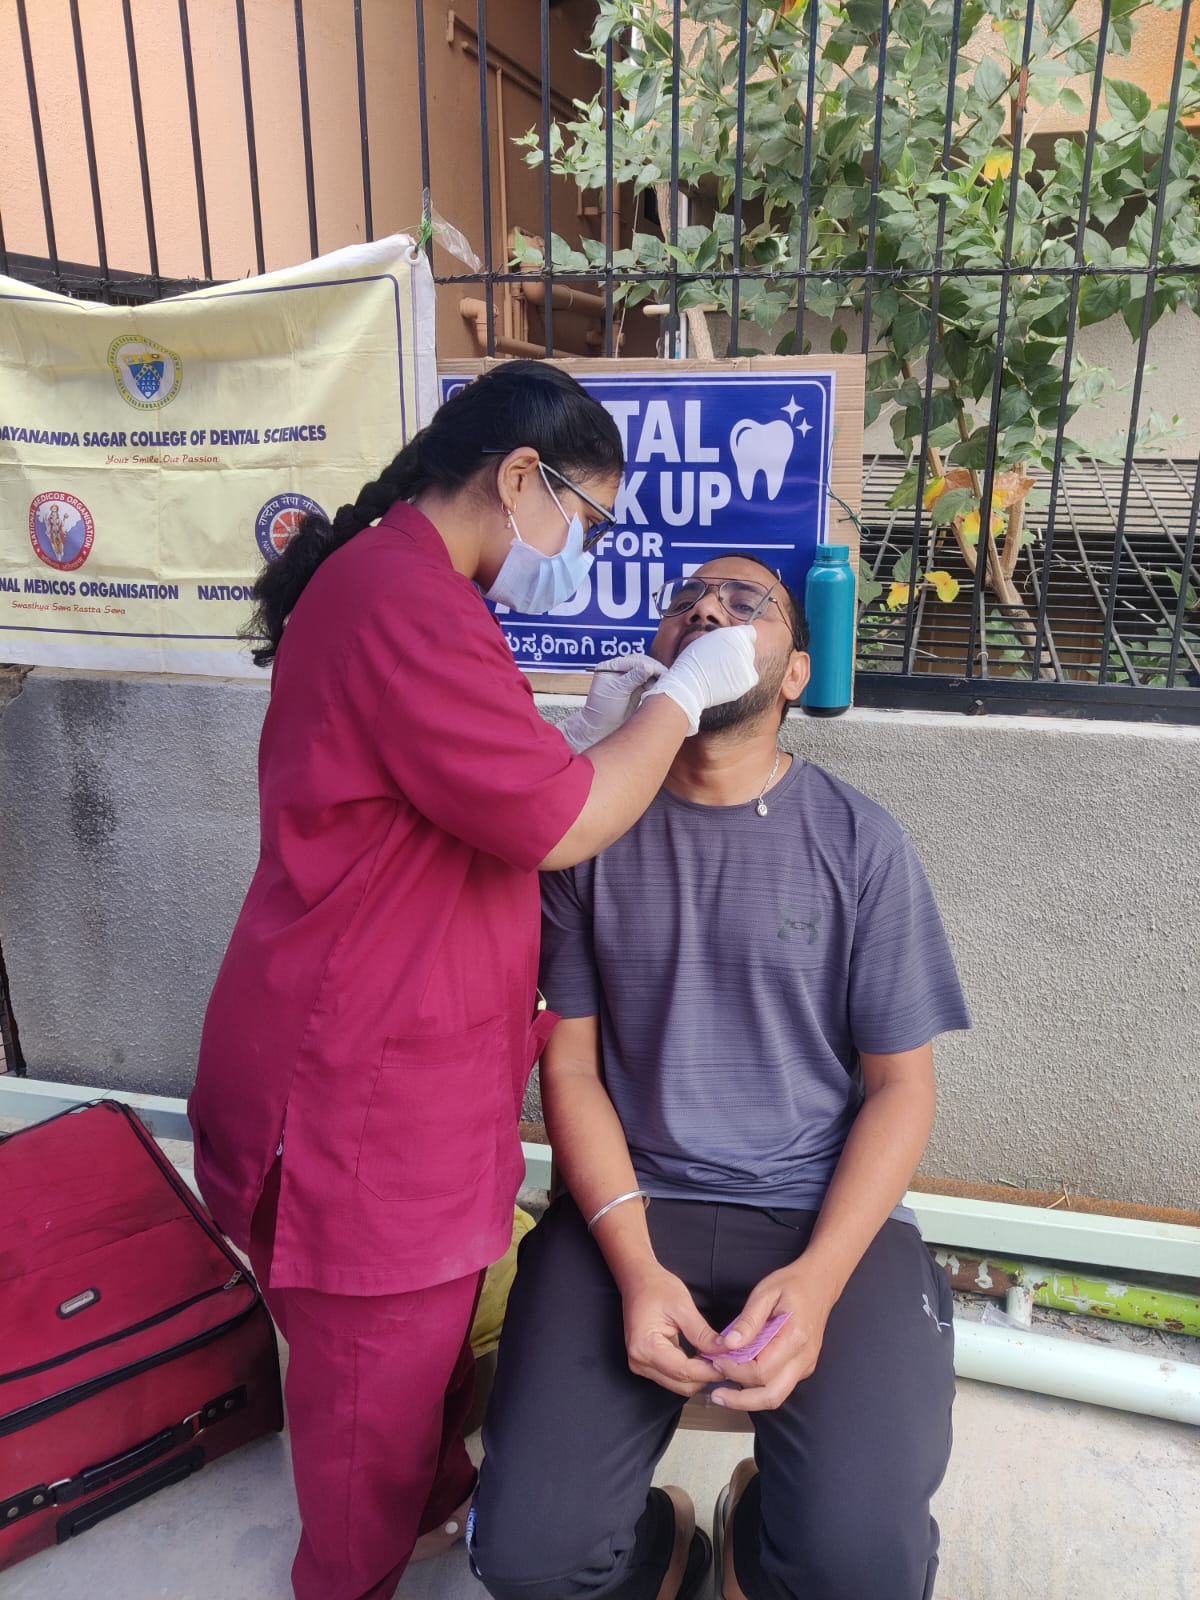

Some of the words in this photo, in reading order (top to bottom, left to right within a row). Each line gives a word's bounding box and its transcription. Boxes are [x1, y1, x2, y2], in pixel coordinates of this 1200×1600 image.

[0, 425, 80, 447] AYANANDA
[83, 431, 127, 447] SAGAR
[130, 431, 187, 447] COLLEGE
[190, 429, 207, 446] OF
[210, 429, 260, 446] DENTAL
[263, 424, 327, 444] SCIENCES
[182, 454, 218, 463] Passion
[659, 471, 732, 526] UP
[33, 492, 65, 507] MEDICOS
[66, 496, 93, 549] ORGANISATION
[596, 531, 664, 558] FOR
[24, 578, 76, 596] MEDICOS
[79, 581, 179, 600] ORGANISATION
